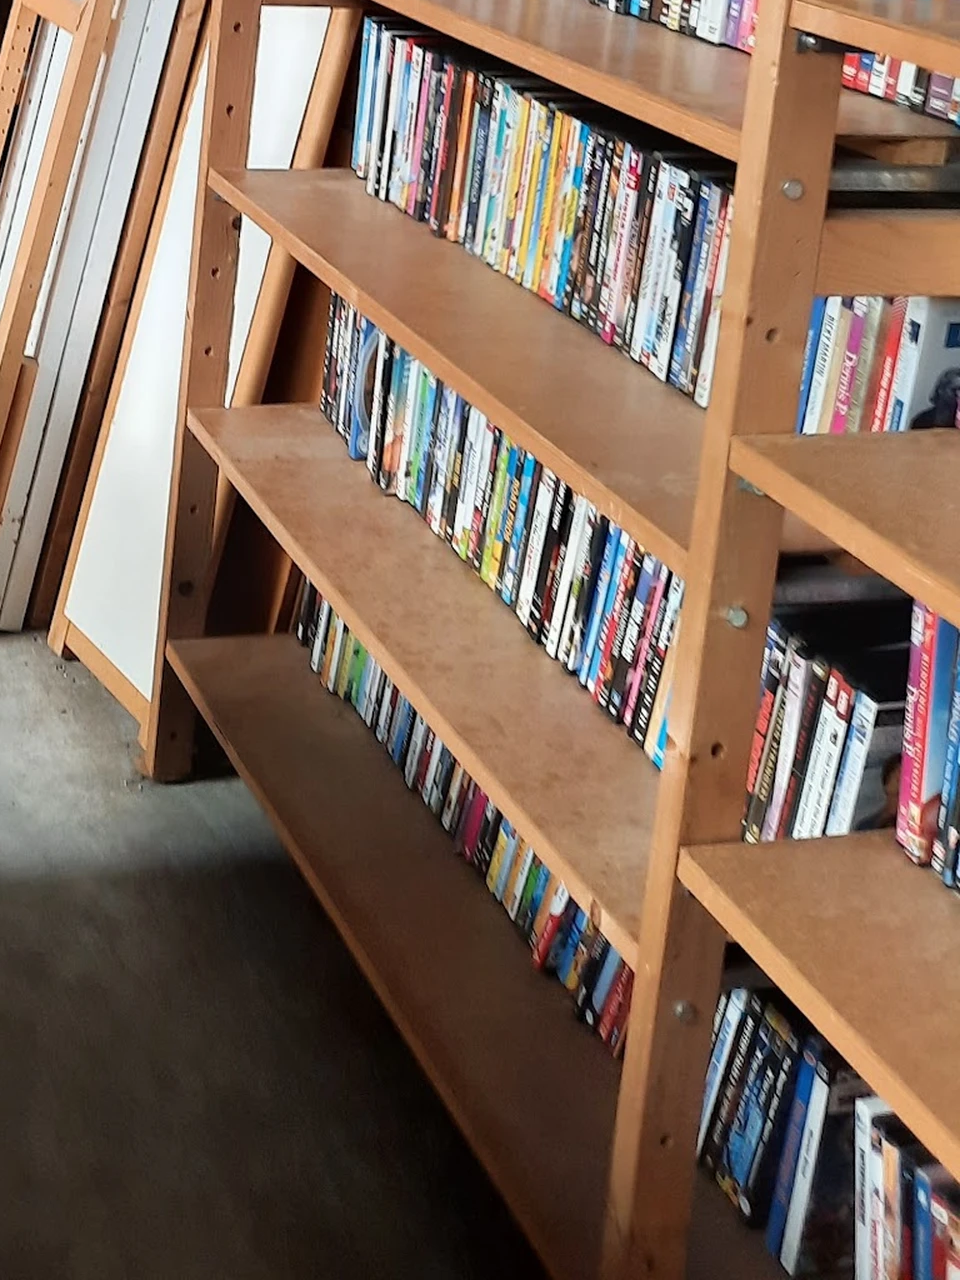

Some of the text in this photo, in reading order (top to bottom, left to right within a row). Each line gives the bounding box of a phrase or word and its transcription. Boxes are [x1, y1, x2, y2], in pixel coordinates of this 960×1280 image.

[815, 313, 835, 377] RICKY MARTIN
[836, 350, 858, 401] Dennis
[916, 651, 929, 715] RUNNING
